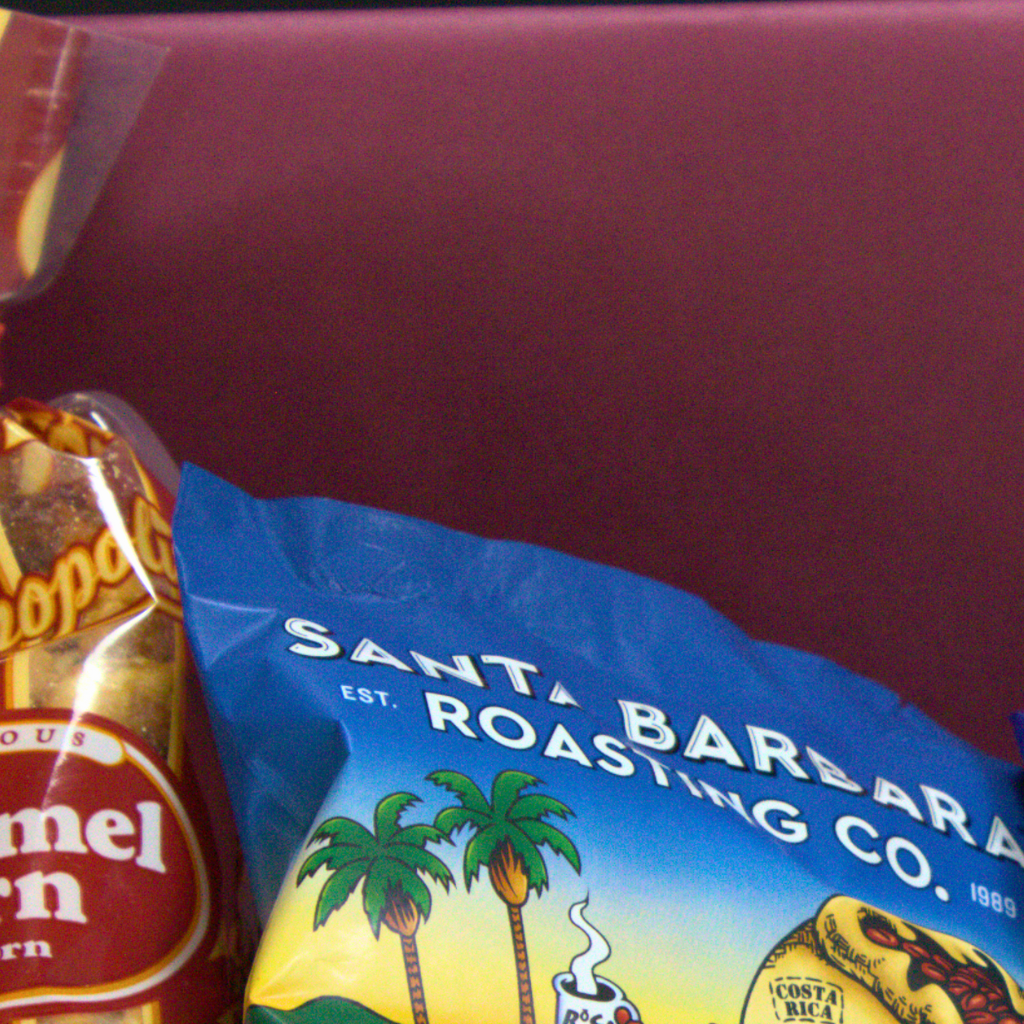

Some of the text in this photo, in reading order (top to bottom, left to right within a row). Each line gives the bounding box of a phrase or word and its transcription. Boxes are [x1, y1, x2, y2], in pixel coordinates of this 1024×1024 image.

[283, 617, 584, 710] SANTA
[340, 685, 398, 709] EST.
[424, 692, 949, 902] ROASTING CO.
[970, 882, 1017, 919] 1989
[775, 982, 838, 1006] COSTA
[785, 1002, 833, 1020] RICA
